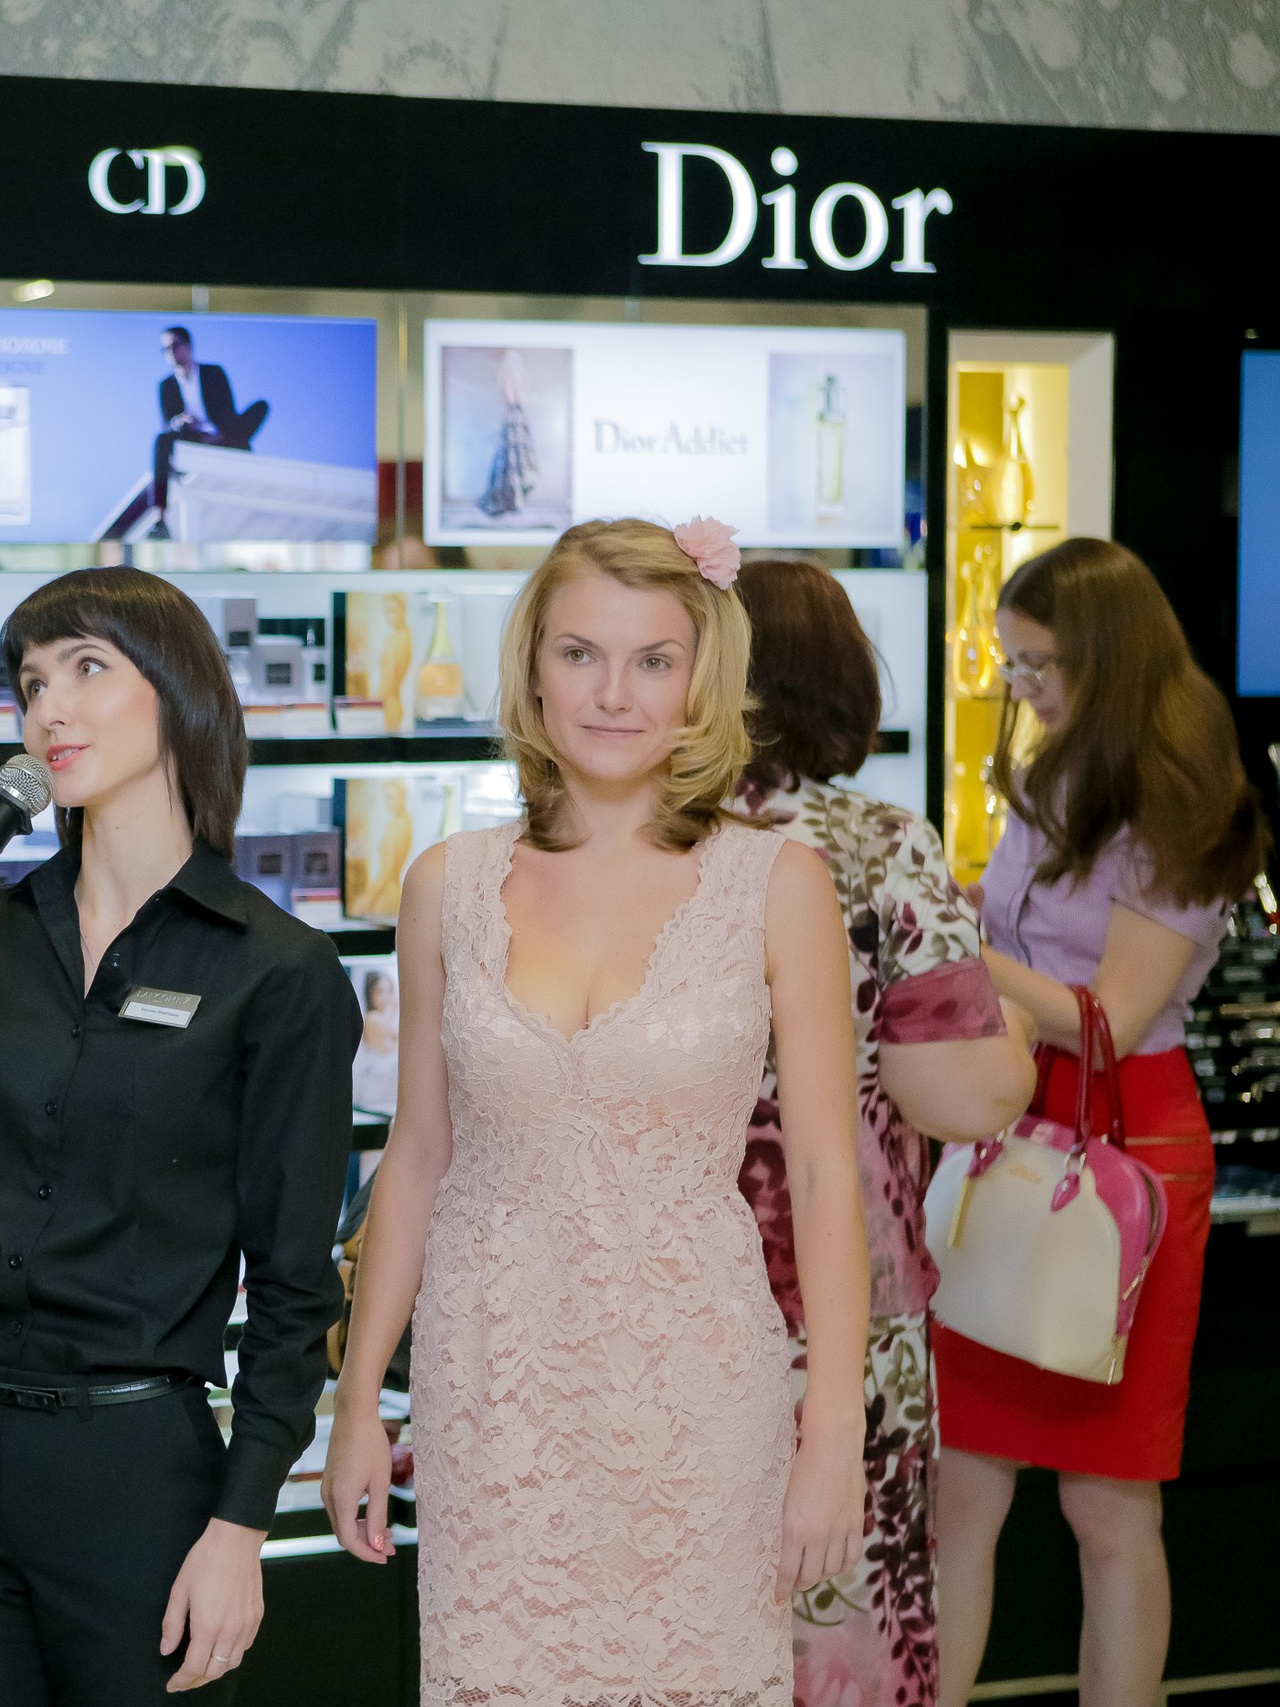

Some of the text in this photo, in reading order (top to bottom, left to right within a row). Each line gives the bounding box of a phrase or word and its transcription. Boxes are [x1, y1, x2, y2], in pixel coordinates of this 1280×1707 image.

[88, 146, 206, 215] CD
[637, 141, 953, 273] Dior
[593, 417, 748, 456] Dior Addict
